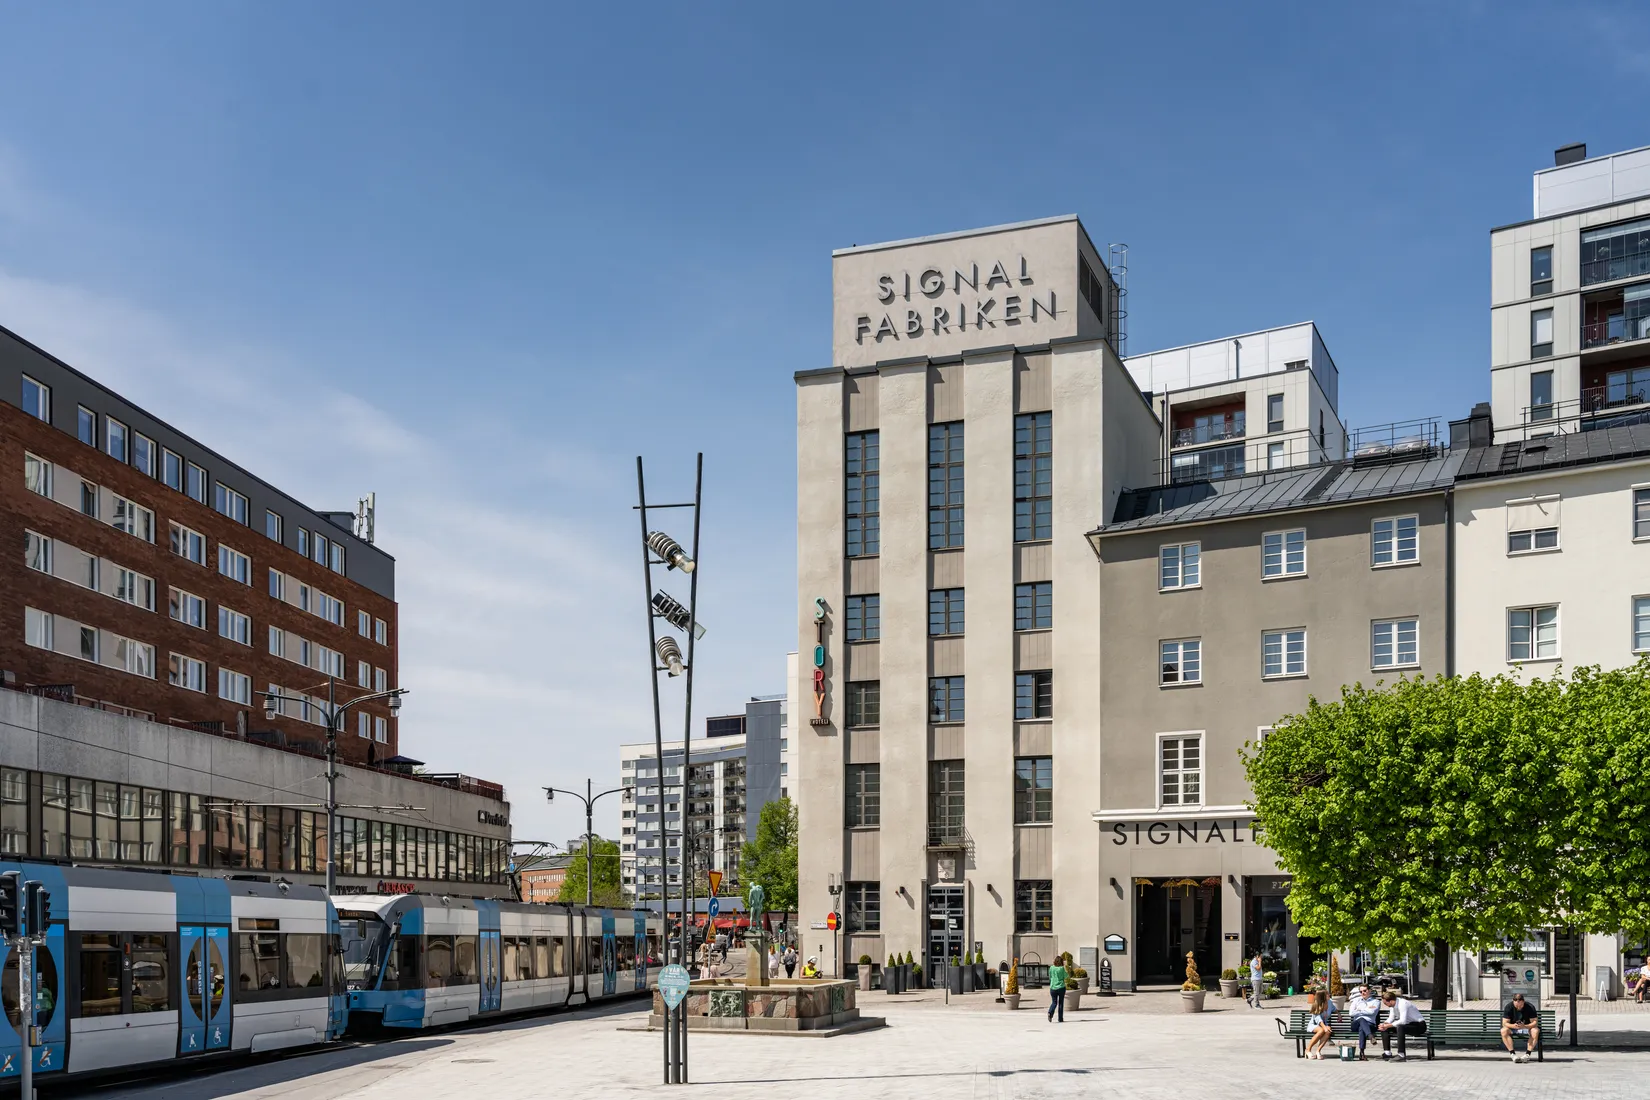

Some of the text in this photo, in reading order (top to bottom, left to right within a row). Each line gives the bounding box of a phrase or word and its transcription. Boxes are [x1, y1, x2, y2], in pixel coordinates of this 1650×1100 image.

[877, 254, 1031, 302] SIGNAL
[855, 289, 1055, 343] FABRIKEN
[814, 596, 826, 718] STORY
